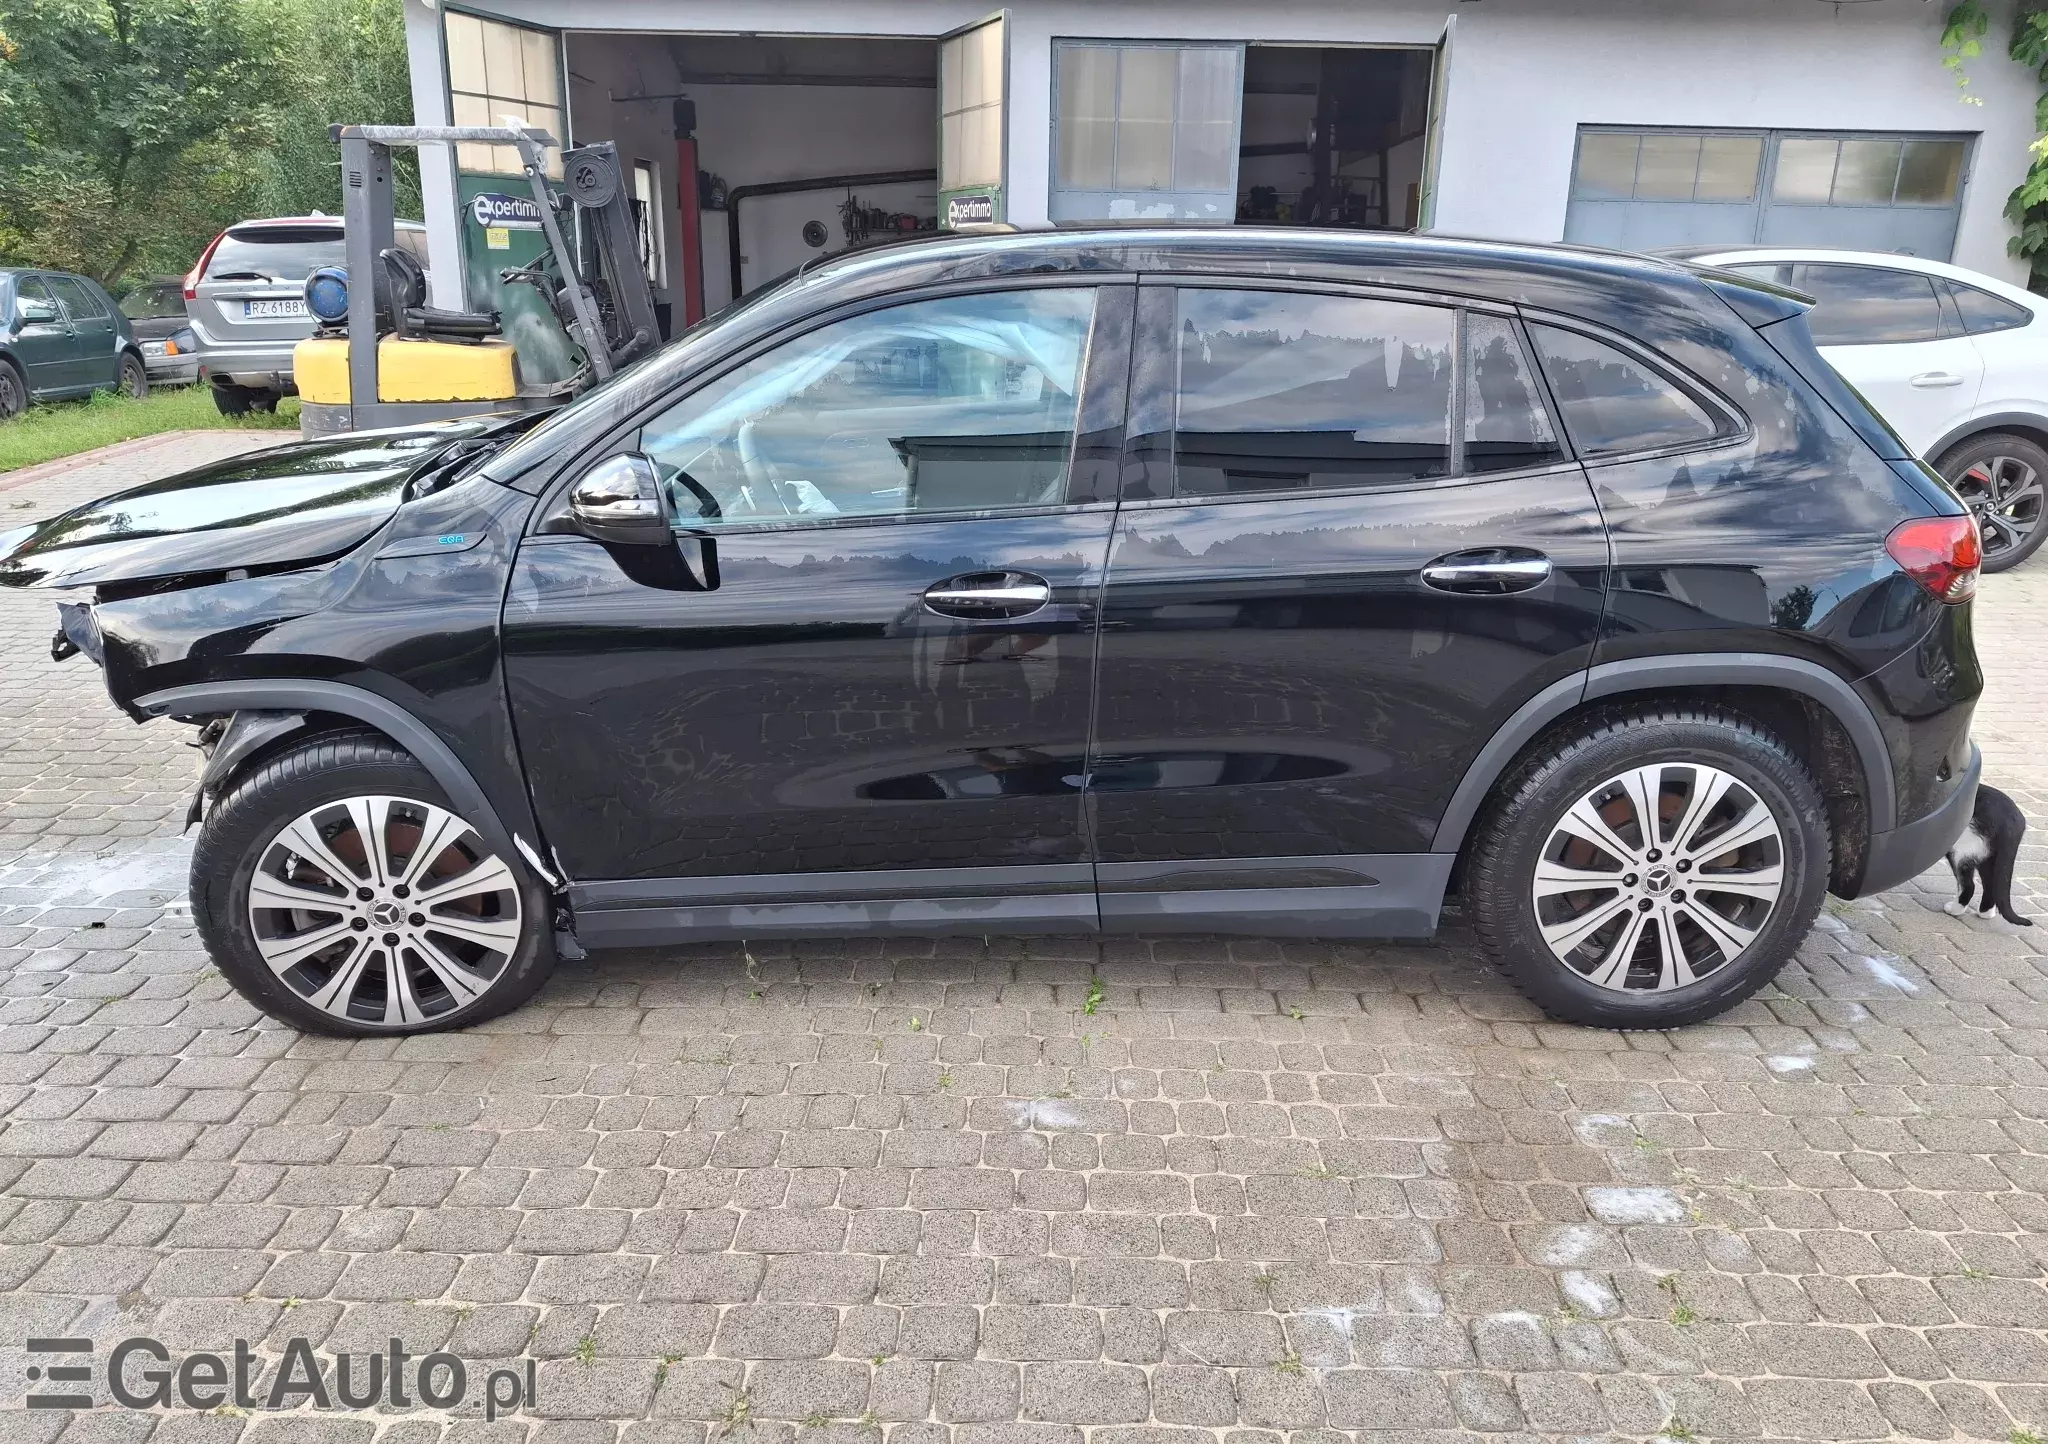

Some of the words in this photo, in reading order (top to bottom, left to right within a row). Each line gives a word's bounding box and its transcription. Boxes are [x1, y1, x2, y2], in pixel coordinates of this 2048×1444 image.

[474, 195, 541, 225] expertim
[948, 200, 992, 229] expertimmo
[252, 302, 267, 314] RZ
[271, 301, 306, 314] 6188Y
[438, 535, 464, 544] EQA
